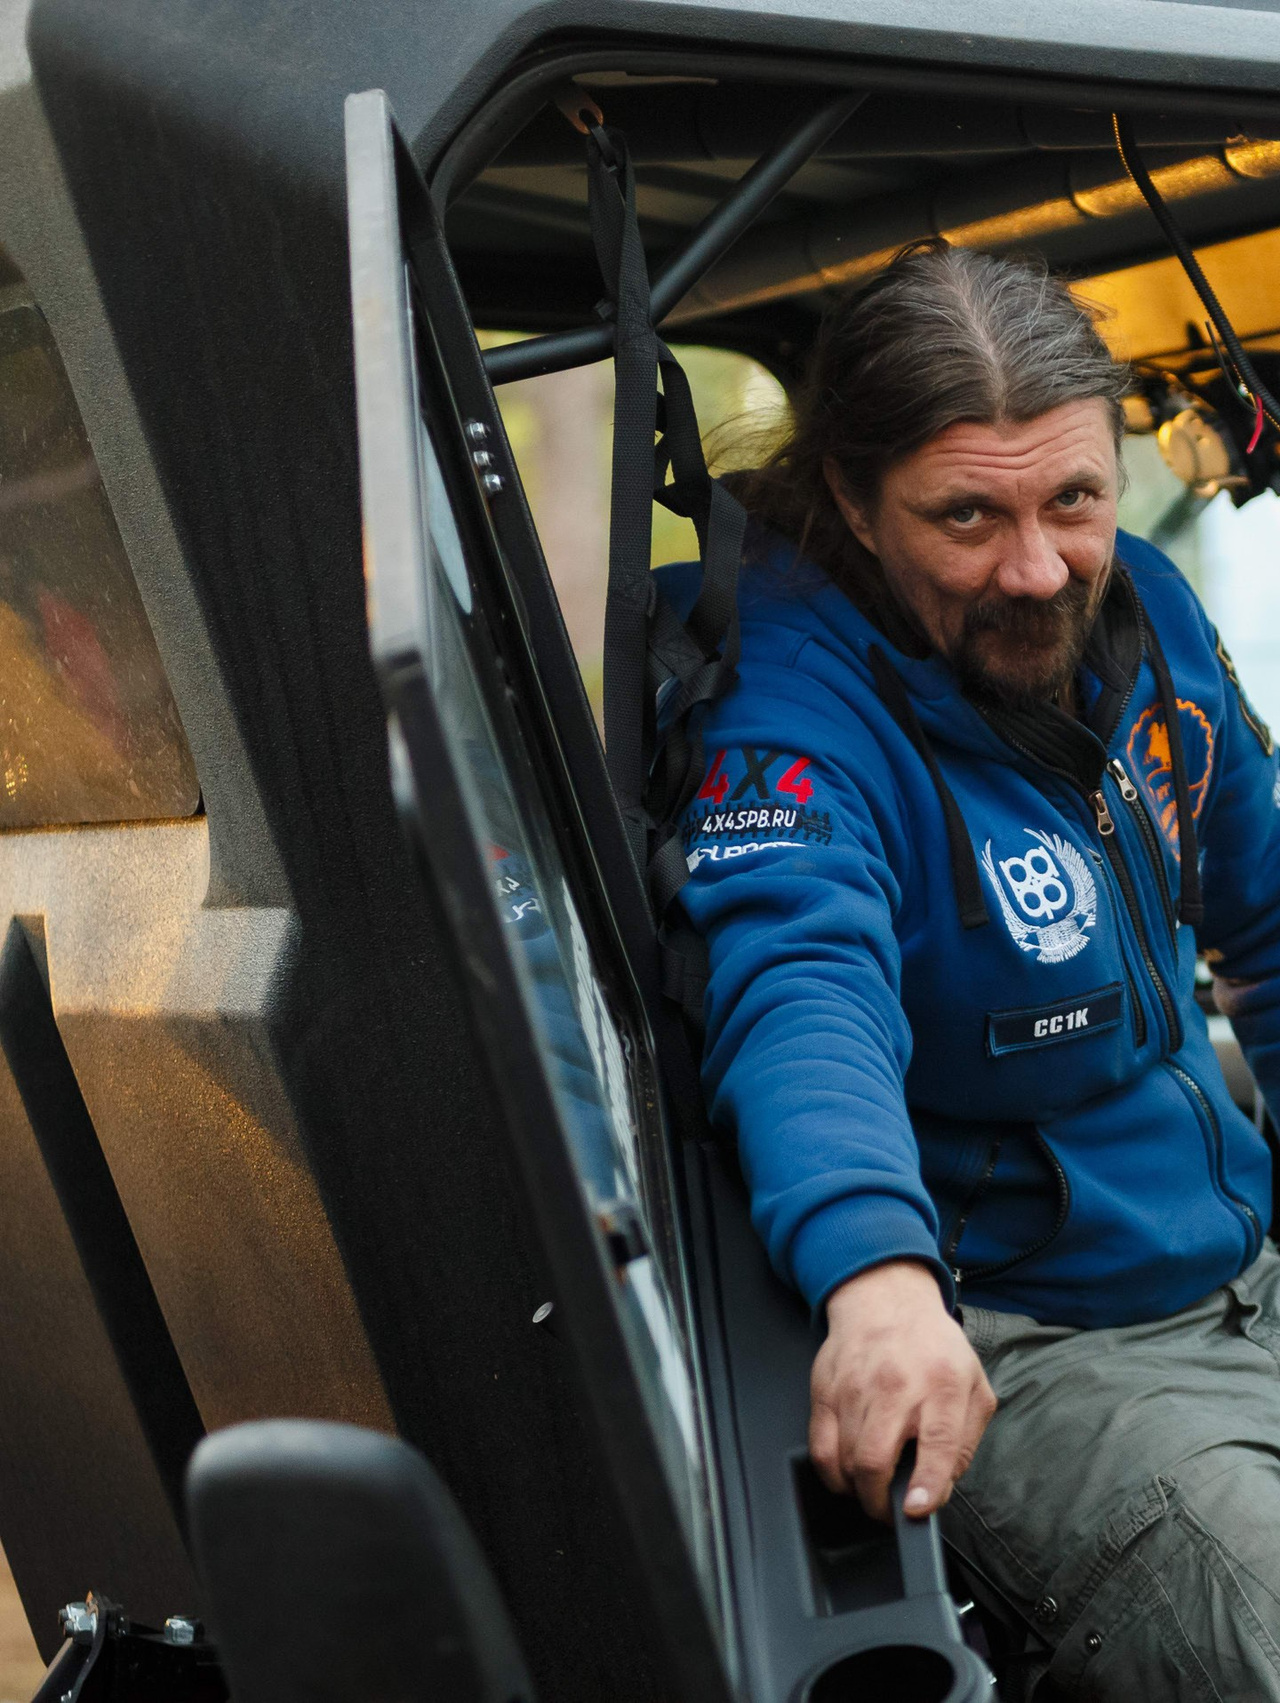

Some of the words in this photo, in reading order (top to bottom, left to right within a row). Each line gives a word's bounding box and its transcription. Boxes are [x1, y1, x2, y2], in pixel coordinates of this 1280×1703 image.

[698, 747, 814, 804] 4X4
[702, 808, 797, 833] 4X4SPB.RU
[1034, 1007, 1089, 1037] CC1K
